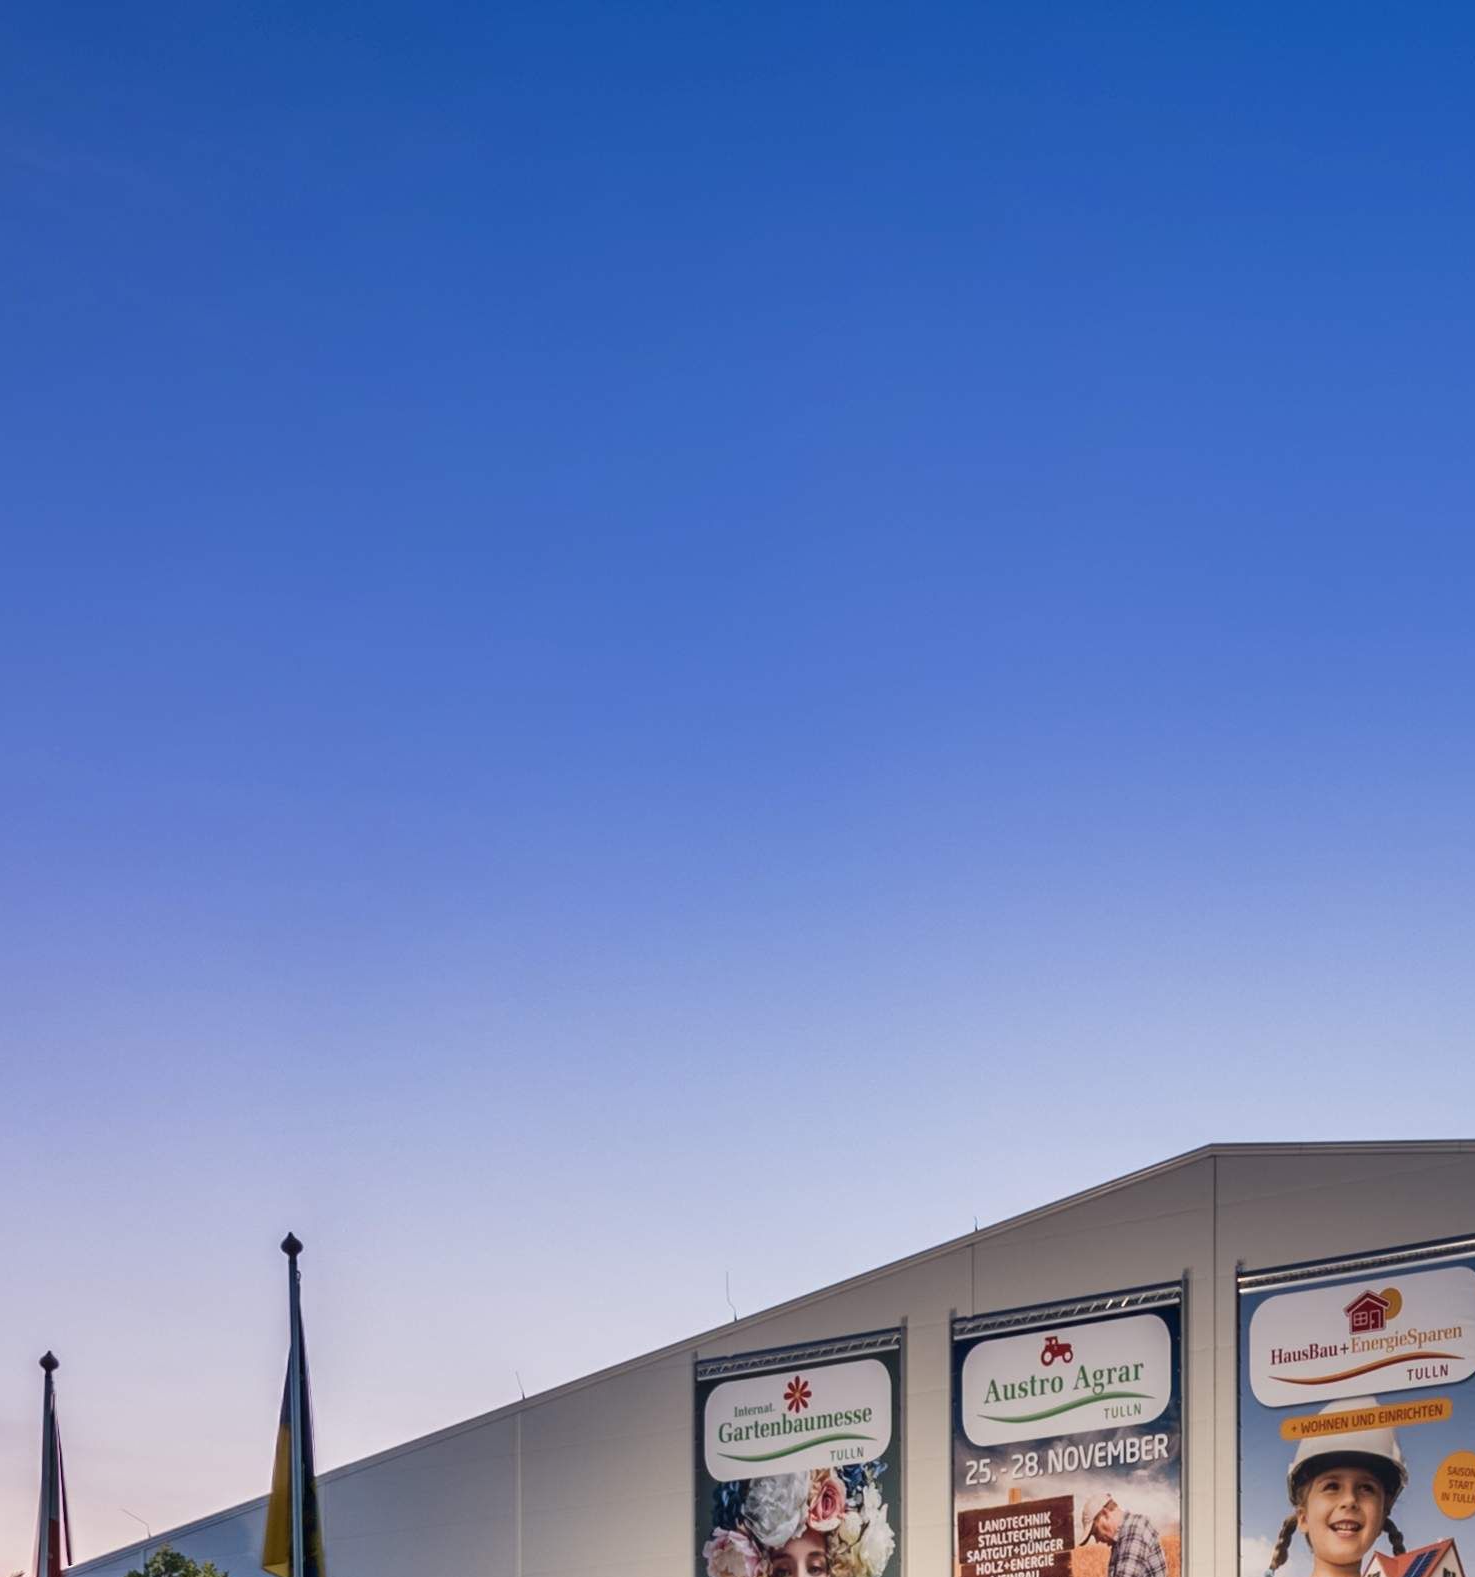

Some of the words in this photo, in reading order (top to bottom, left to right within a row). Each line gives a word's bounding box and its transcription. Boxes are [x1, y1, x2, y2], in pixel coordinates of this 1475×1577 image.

[984, 1374, 1064, 1404] Austro
[1073, 1362, 1144, 1395] Agrar
[1407, 1364, 1449, 1381] TULLN
[733, 1402, 775, 1418] Internat.
[1103, 1403, 1142, 1420] TULLN
[1300, 1417, 1349, 1434] WOHNEN
[1352, 1413, 1376, 1427] UND
[1378, 1403, 1443, 1424] EINRICHTEN
[718, 1406, 872, 1444] Gartenbaumesse
[829, 1447, 865, 1462] TULLN
[965, 1458, 997, 1485] 25.
[1011, 1453, 1044, 1480] 28.
[1047, 1433, 1169, 1473] NOVEMBER
[1448, 1479, 1475, 1490] START
[1441, 1491, 1450, 1501] IN
[978, 1511, 1051, 1534] LANDTECHNIK
[977, 1526, 1052, 1548] STALLTECHNIK
[966, 1538, 1064, 1563] SAATGUT+DÜNGER
[976, 1554, 1055, 1576] HOLZ+ENERGIE
